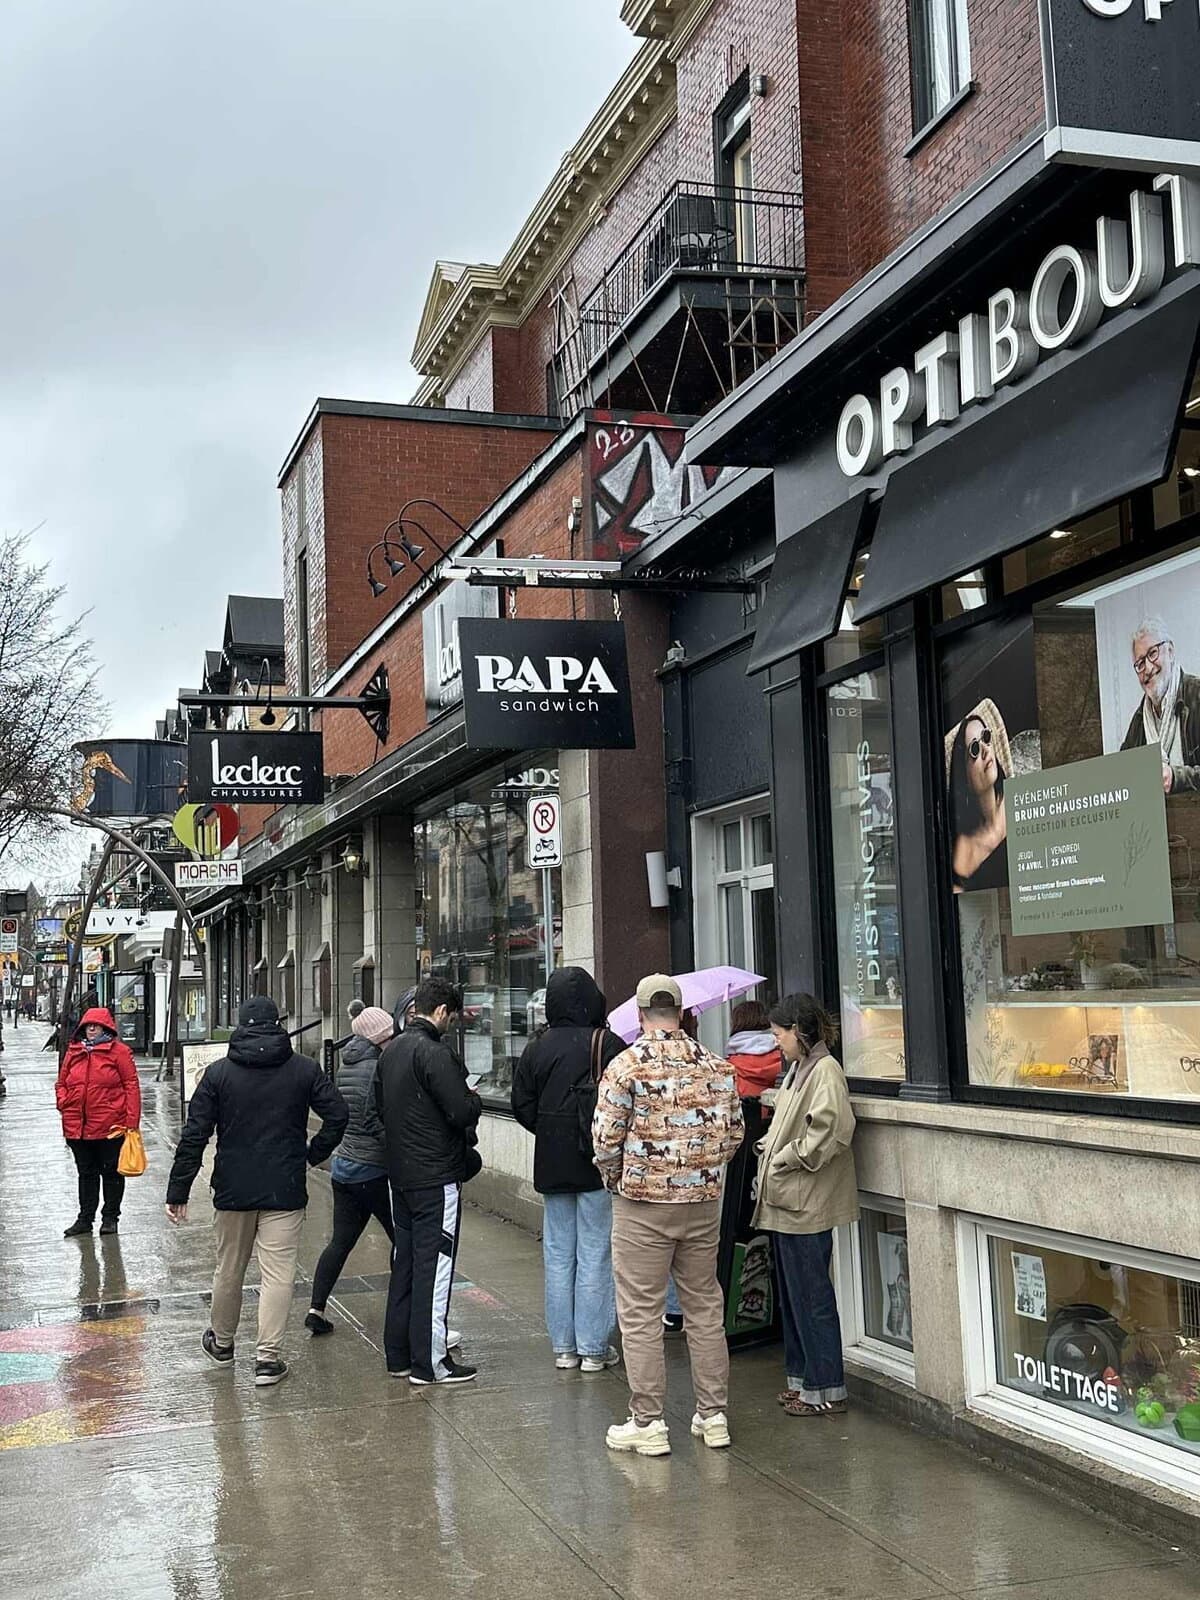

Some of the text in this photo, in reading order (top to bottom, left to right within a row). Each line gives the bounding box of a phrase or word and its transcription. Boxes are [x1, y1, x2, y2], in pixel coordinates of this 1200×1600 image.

[474, 655, 618, 693] PAPA
[500, 699, 599, 712] sandwich
[211, 738, 303, 785] leclerc
[211, 789, 303, 797] CHAUSSURES
[1015, 788, 1129, 822] BRUNO CHAUSSIGNAND
[1015, 808, 1121, 837] COLLECTION EXCLUSIVE
[1051, 842, 1080, 855] VENDREDI
[180, 863, 238, 879] MORENA
[857, 740, 881, 982] DISTINCTIVES
[1026, 861, 1044, 870] AVRIL
[1060, 855, 1078, 865] AVRIL
[92, 916, 133, 927] IVY
[853, 901, 865, 997] MONTURES
[1013, 1352, 1119, 1412] TOILETTAGE
